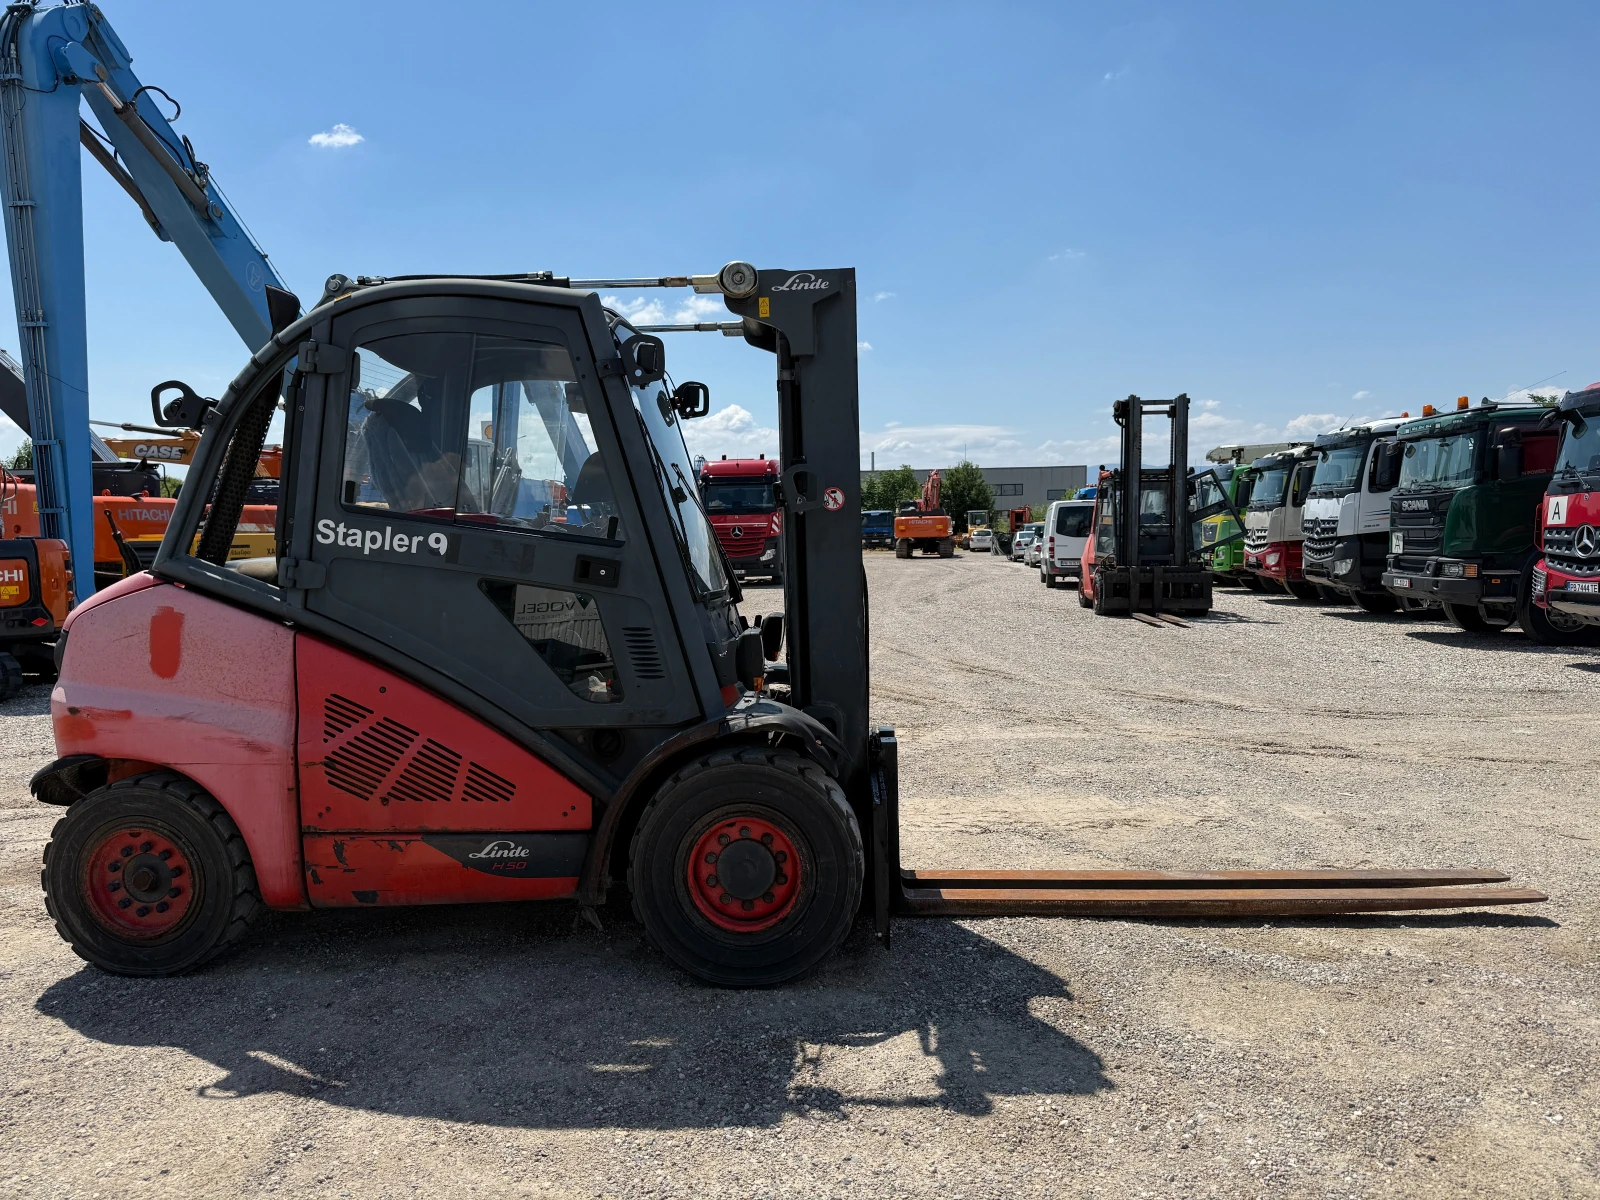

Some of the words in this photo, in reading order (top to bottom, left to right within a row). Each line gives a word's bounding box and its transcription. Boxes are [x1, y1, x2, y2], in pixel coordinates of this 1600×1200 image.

[771, 272, 829, 292] Linde
[134, 443, 184, 460] CASE
[118, 508, 171, 520] HITACHI
[1402, 500, 1429, 511] SCANIA
[1551, 501, 1561, 521] A
[316, 519, 424, 555] Stapler
[427, 532, 448, 556] 9
[468, 840, 530, 859] Linde
